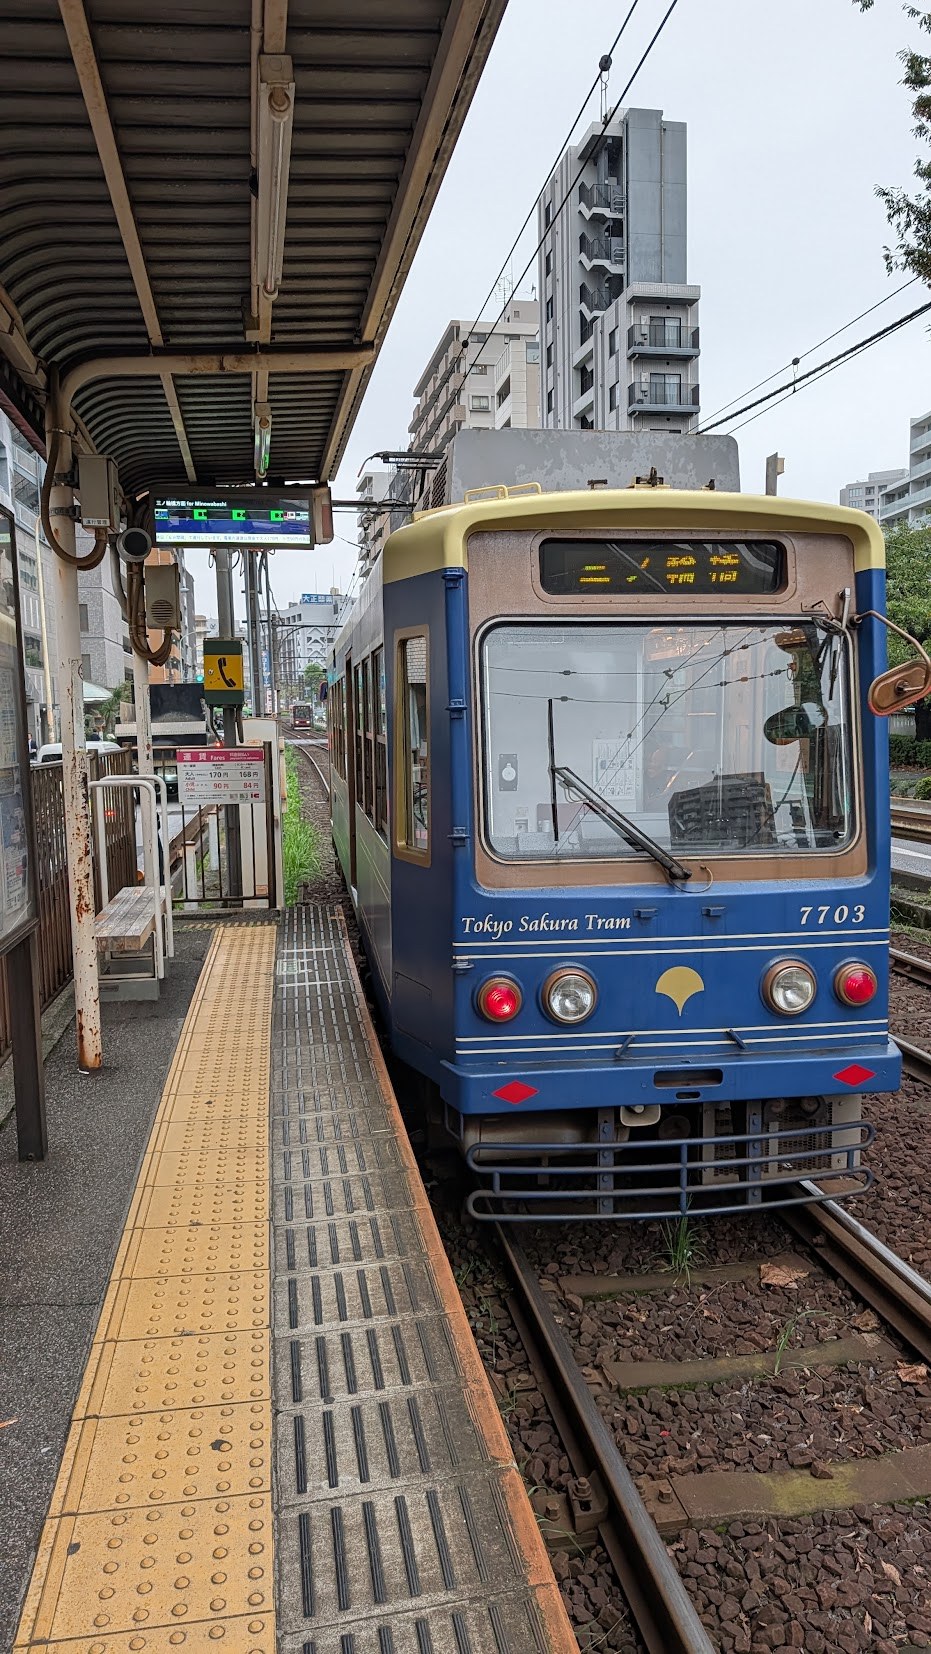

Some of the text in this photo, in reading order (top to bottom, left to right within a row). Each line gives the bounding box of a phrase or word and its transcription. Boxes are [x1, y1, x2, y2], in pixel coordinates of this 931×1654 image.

[461, 912, 632, 940] Tokyo Sakura Tram
[800, 904, 866, 925] 7703
